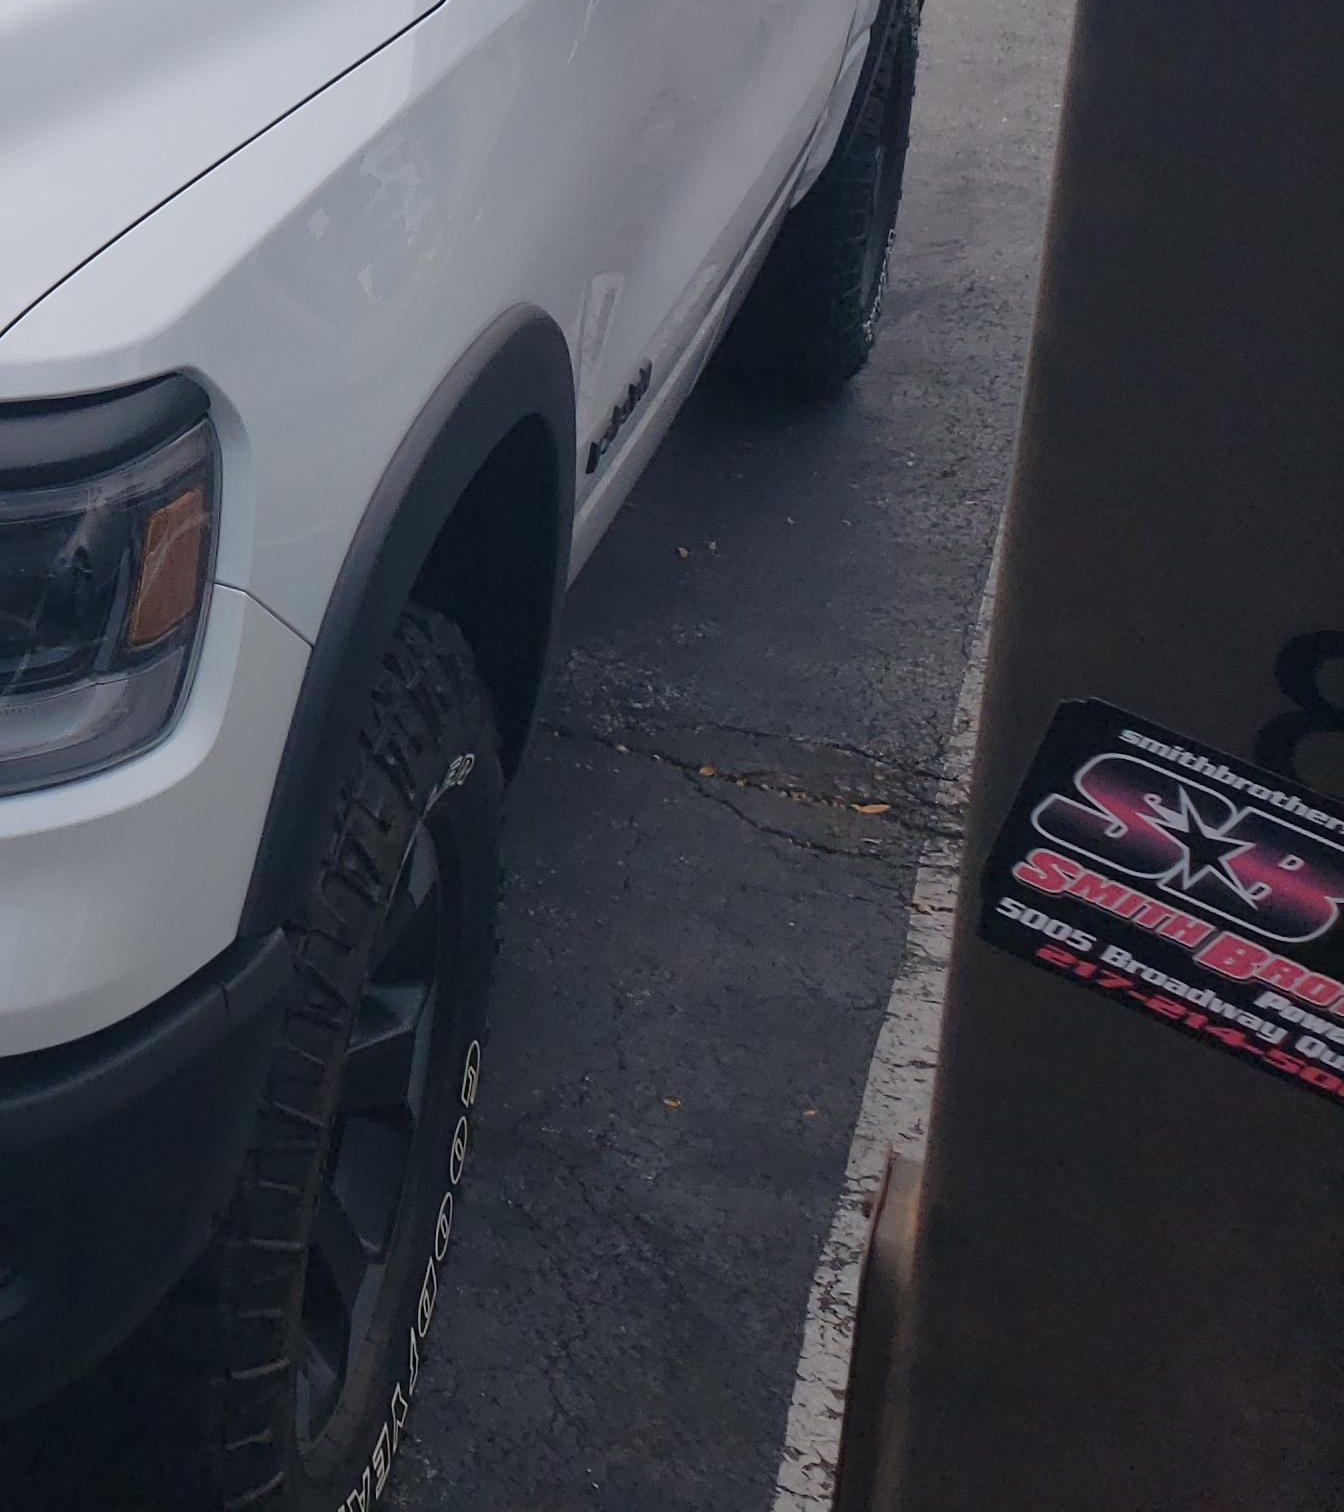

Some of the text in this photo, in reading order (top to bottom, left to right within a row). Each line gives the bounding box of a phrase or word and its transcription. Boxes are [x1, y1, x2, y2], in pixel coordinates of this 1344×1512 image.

[996, 896, 1097, 953] 5005
[1100, 944, 1289, 1045] Broadway
[1012, 848, 1217, 950] SMITH
[1035, 943, 1344, 1098] 217-214-50
